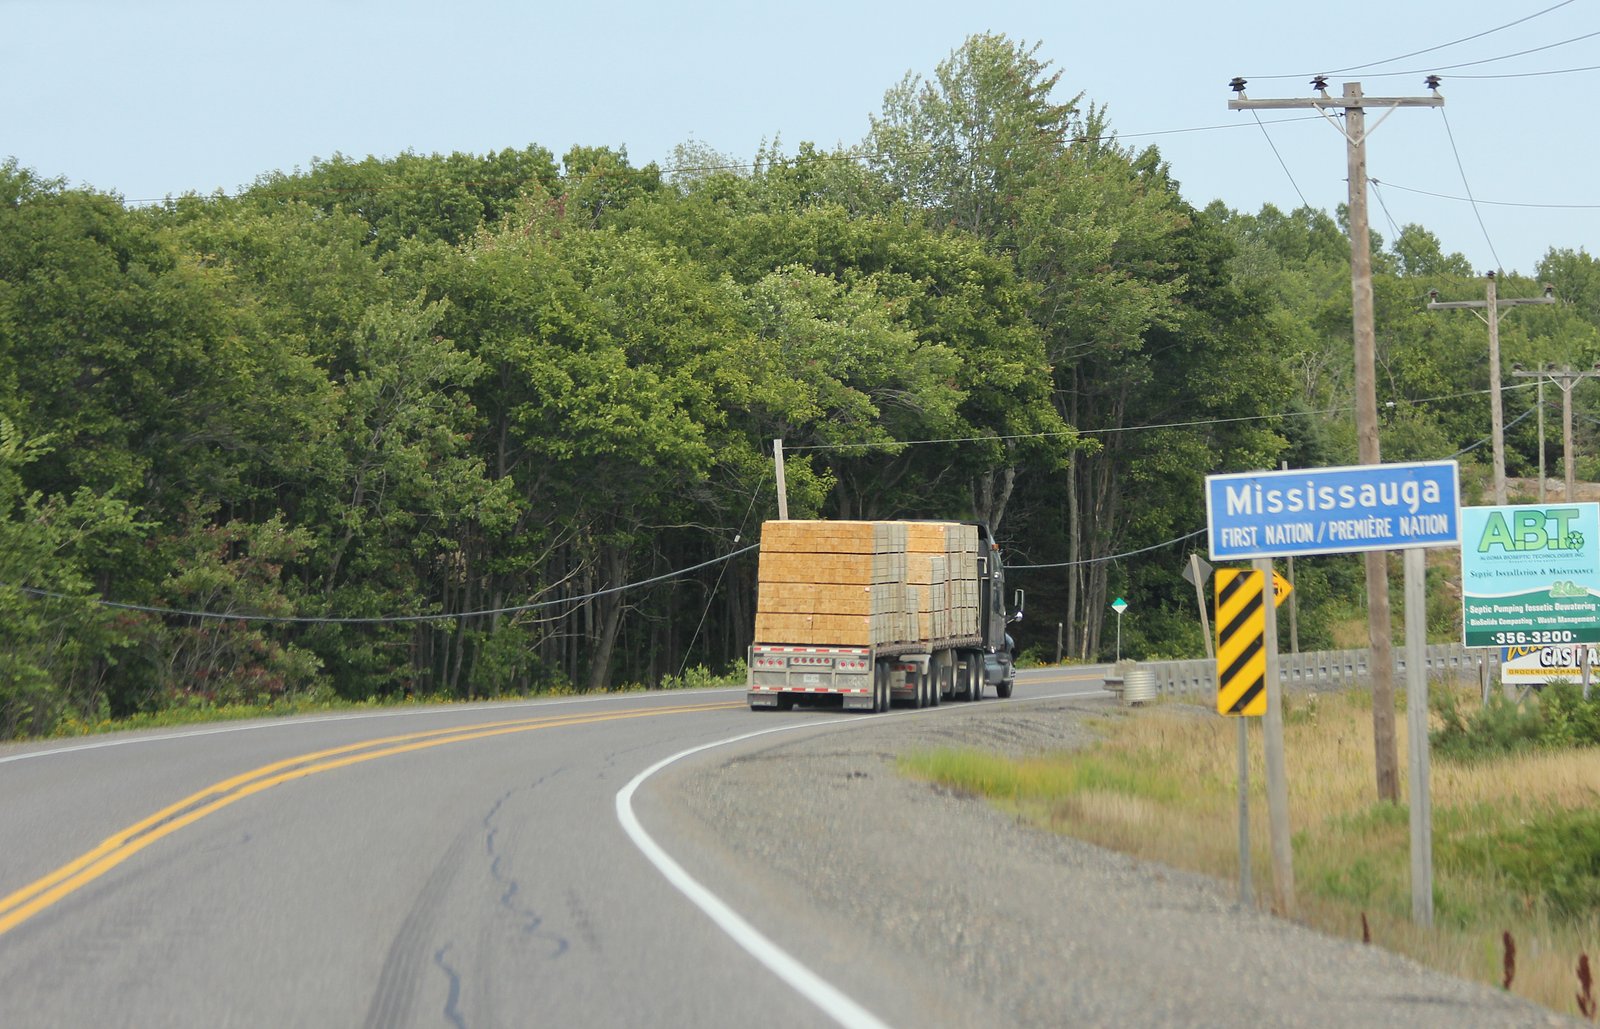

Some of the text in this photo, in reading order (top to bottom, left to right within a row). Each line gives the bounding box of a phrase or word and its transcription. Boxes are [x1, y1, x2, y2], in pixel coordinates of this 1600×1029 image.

[1226, 479, 1441, 516] Mississauga
[1221, 526, 1258, 548] FIRST
[1265, 522, 1314, 545] NATION
[1328, 515, 1393, 541] PREMIÈRE
[1399, 514, 1448, 537] NATION
[1470, 605, 1492, 615] Septic
[1493, 604, 1524, 614] Pumping
[1554, 602, 1596, 611] Dewatering
[1558, 616, 1596, 624] Management
[1496, 631, 1572, 644] 356-3200
[1540, 647, 1572, 667] GAS
